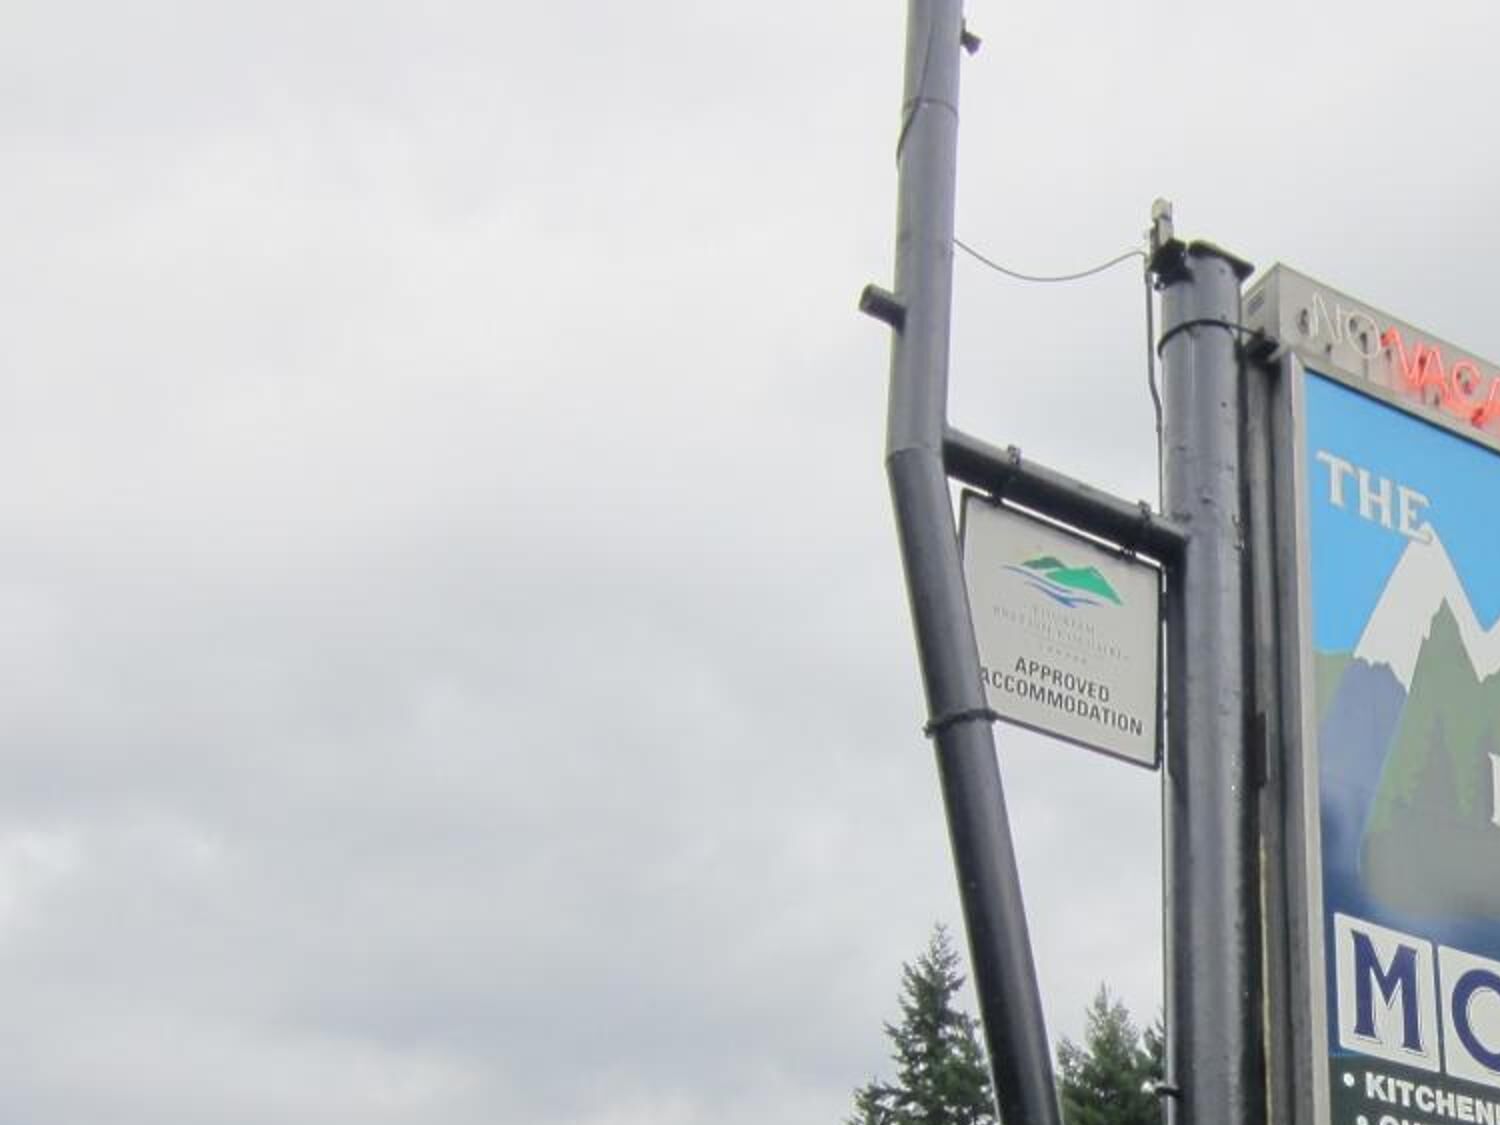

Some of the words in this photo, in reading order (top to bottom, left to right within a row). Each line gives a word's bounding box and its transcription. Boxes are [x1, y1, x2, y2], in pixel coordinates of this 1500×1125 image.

[1306, 292, 1382, 360] NO
[1315, 449, 1434, 545] THE
[980, 667, 1144, 737] ACCOMMODATION
[1014, 655, 1110, 703] APPROVED
